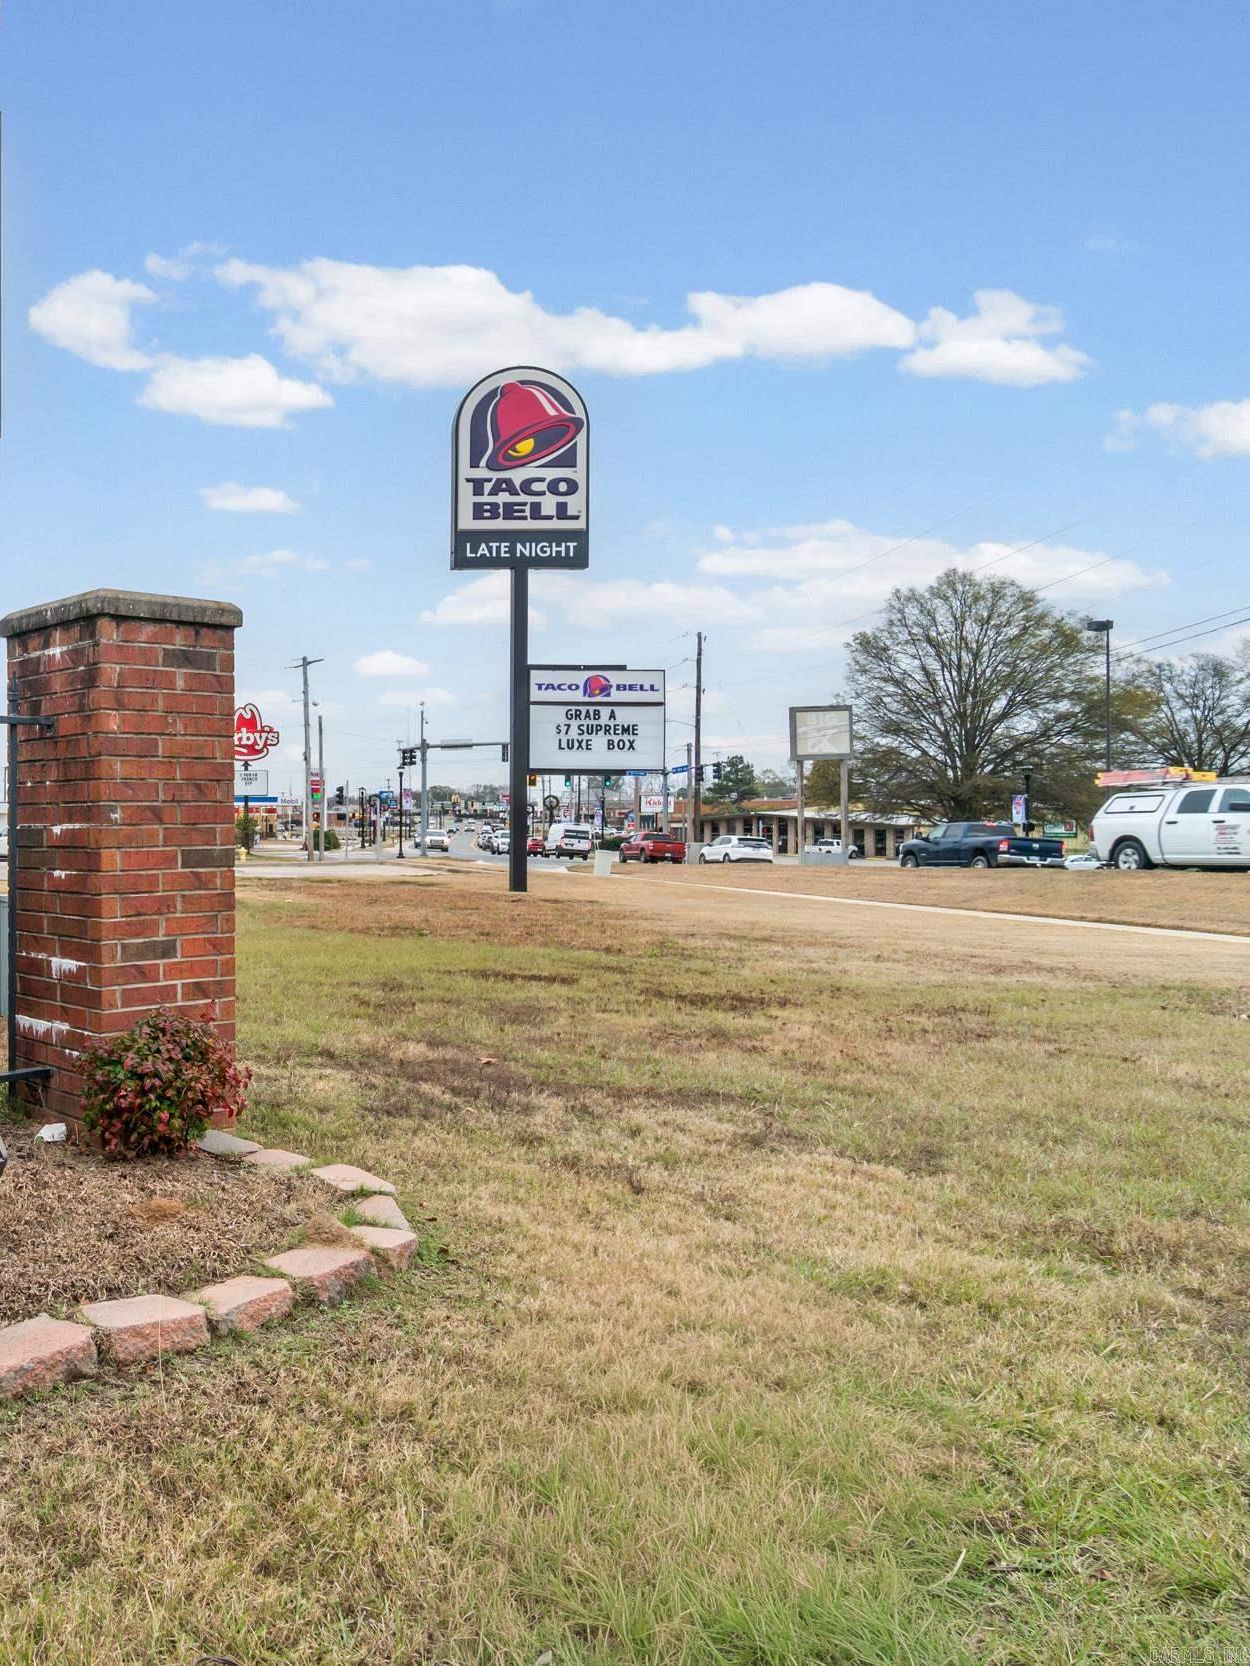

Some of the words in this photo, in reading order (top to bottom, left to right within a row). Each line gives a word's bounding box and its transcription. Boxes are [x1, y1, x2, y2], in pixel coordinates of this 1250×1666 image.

[464, 477, 579, 497] TACO
[472, 501, 581, 521] BELL
[466, 542, 510, 558] LATE
[516, 542, 578, 558] NIGHT
[535, 683, 580, 691] TACO
[616, 683, 660, 692] BELL
[565, 709, 601, 721] GRAB
[608, 709, 617, 721] A
[555, 724, 572, 736] $7
[577, 724, 639, 736] SUPREME
[233, 727, 279, 750] rby's
[558, 739, 593, 751] LUXE
[607, 739, 636, 751] BOX
